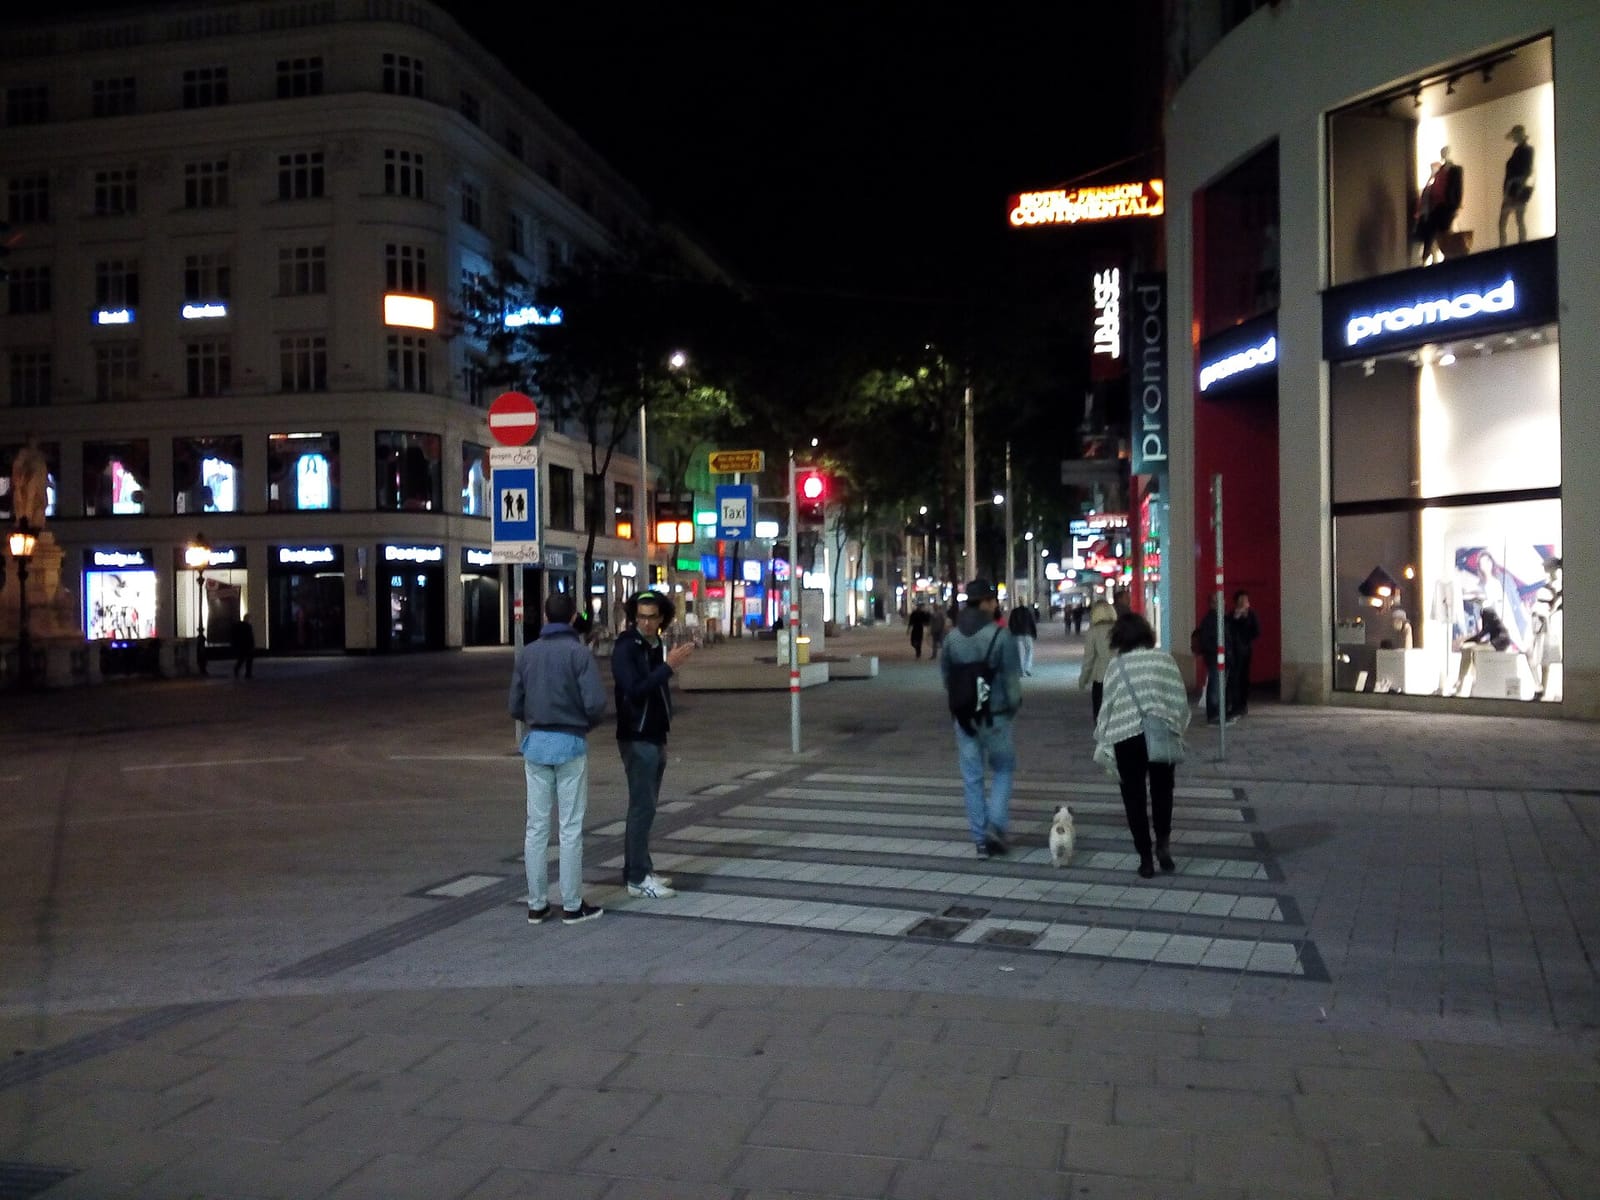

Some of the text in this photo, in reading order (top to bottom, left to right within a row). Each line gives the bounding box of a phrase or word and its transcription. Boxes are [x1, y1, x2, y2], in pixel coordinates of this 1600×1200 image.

[1347, 278, 1515, 347] promod
[1137, 284, 1168, 462] promod
[1199, 335, 1277, 392] promod
[723, 505, 746, 520] Taxi
